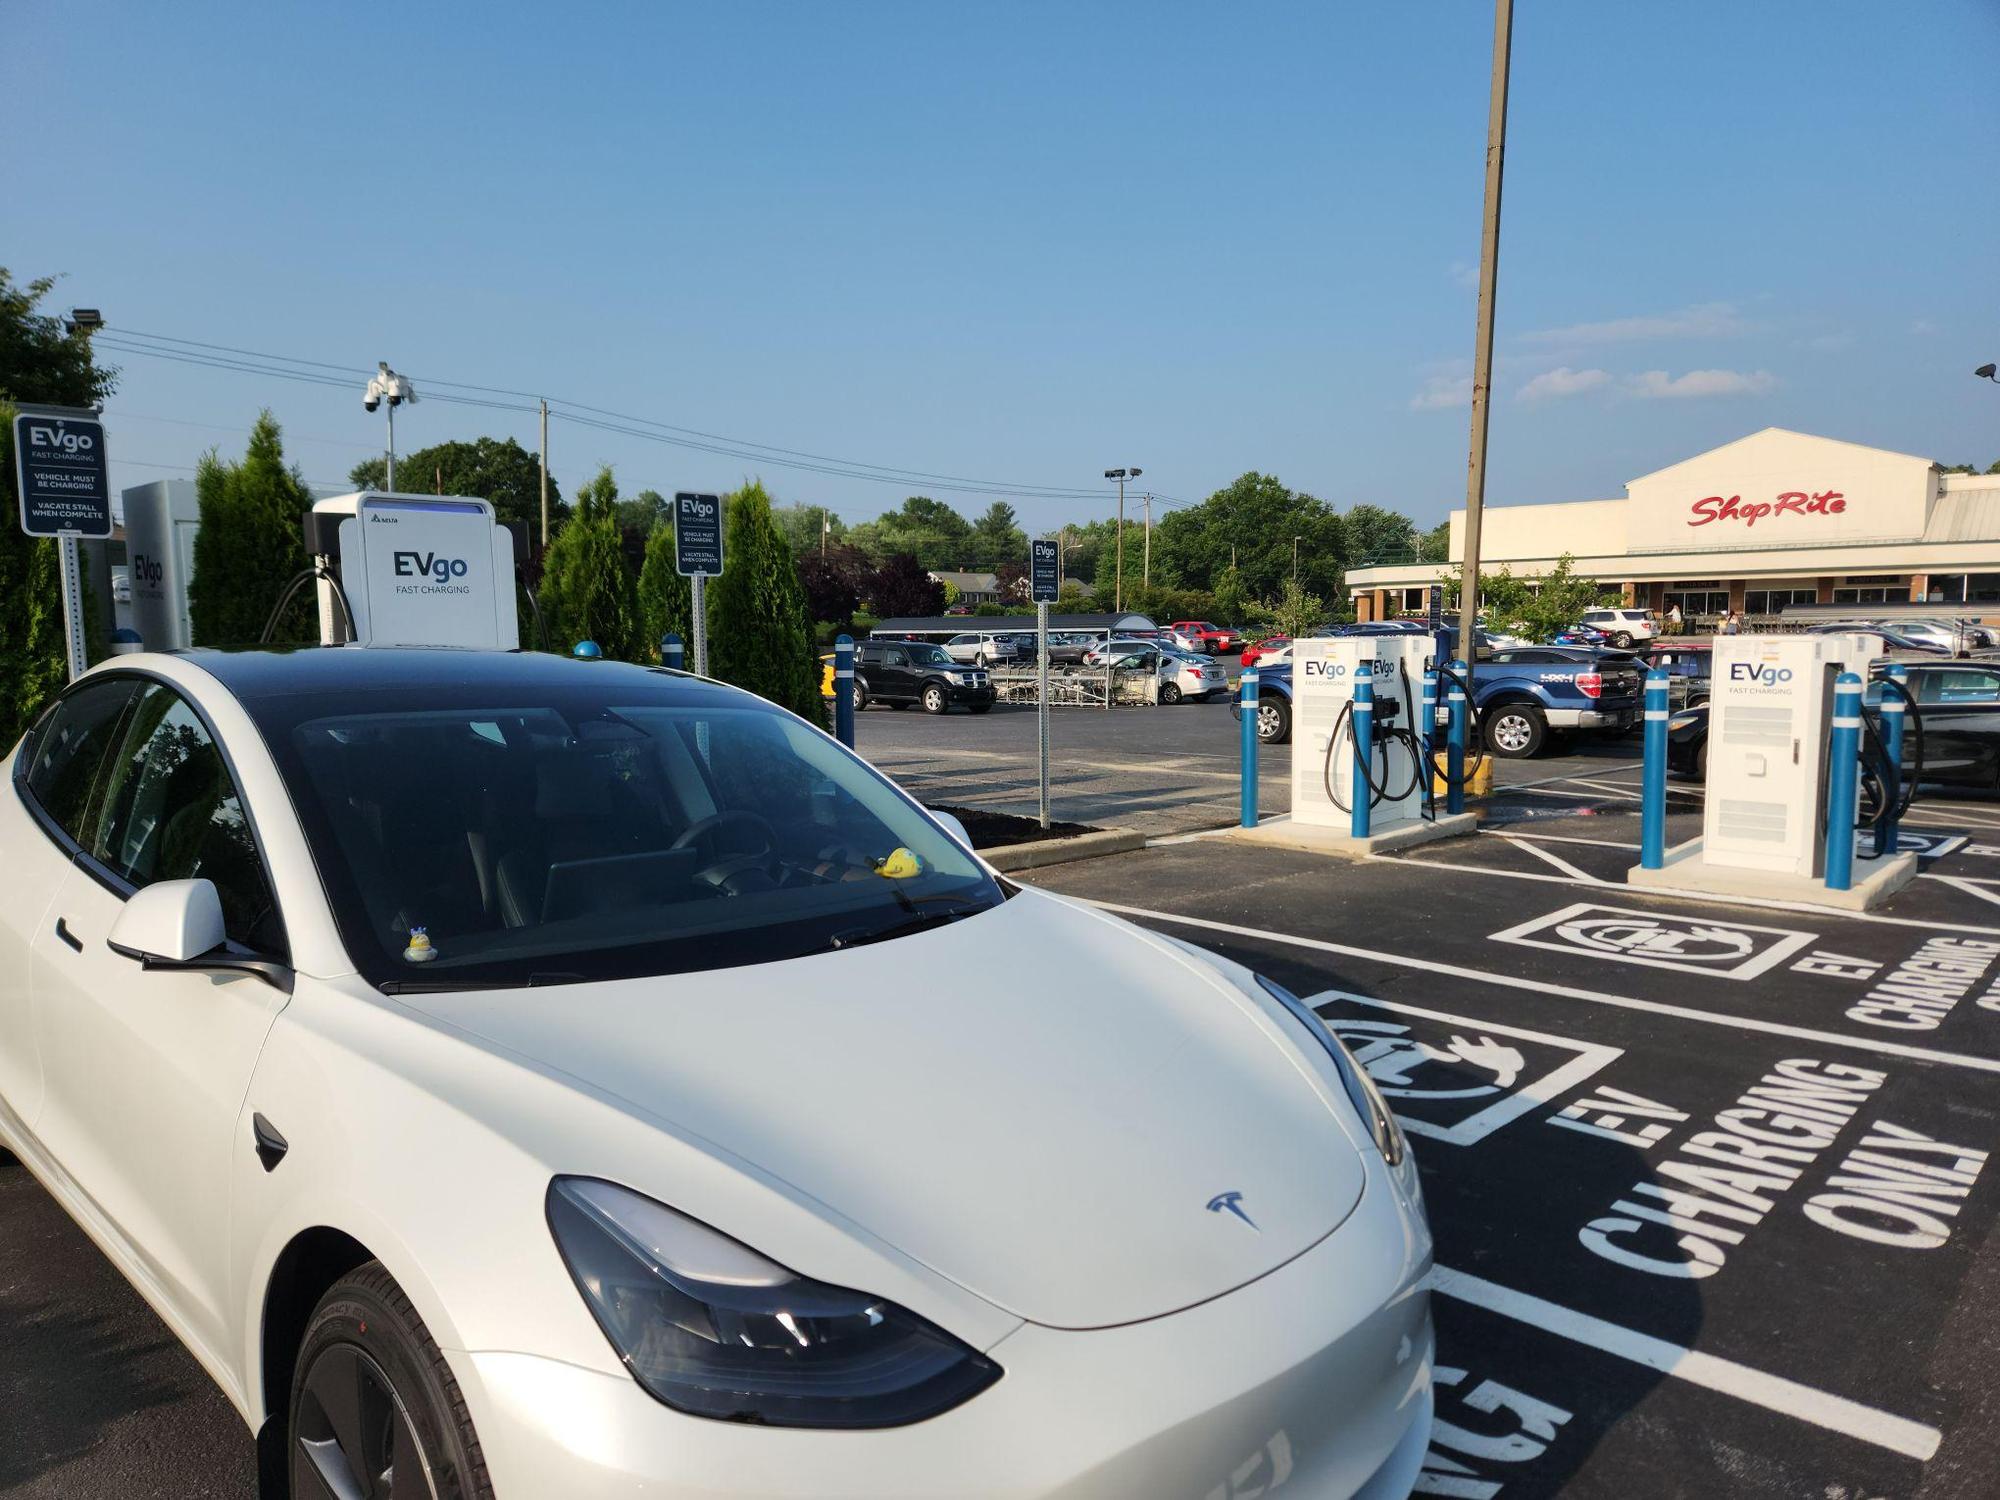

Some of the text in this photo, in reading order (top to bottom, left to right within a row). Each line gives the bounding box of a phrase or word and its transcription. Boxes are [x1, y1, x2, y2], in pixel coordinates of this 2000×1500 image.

[30, 427, 93, 453] EVgo
[31, 451, 95, 462] FAST CHARGING
[34, 473, 96, 483] VEHICLE MUST
[50, 482, 94, 490] CHARGING
[38, 503, 71, 511] VACATE
[60, 511, 104, 519] COMPLETE
[681, 500, 714, 517] EVgo
[1035, 545, 1055, 558] EVgo
[135, 555, 162, 588] EVgo
[394, 552, 468, 583] EVgo
[396, 586, 470, 594] FAST CHARGING
[1306, 661, 1346, 679] EVgo
[1374, 660, 1395, 678] EVgo
[1730, 663, 1793, 686] EVgo
[1789, 950, 1885, 980] EV
[1844, 937, 2000, 1030] CHARGING
[1546, 1086, 1691, 1148] EV
[1579, 1058, 1888, 1279] CHARGING
[1803, 1120, 1991, 1249] ONLY
